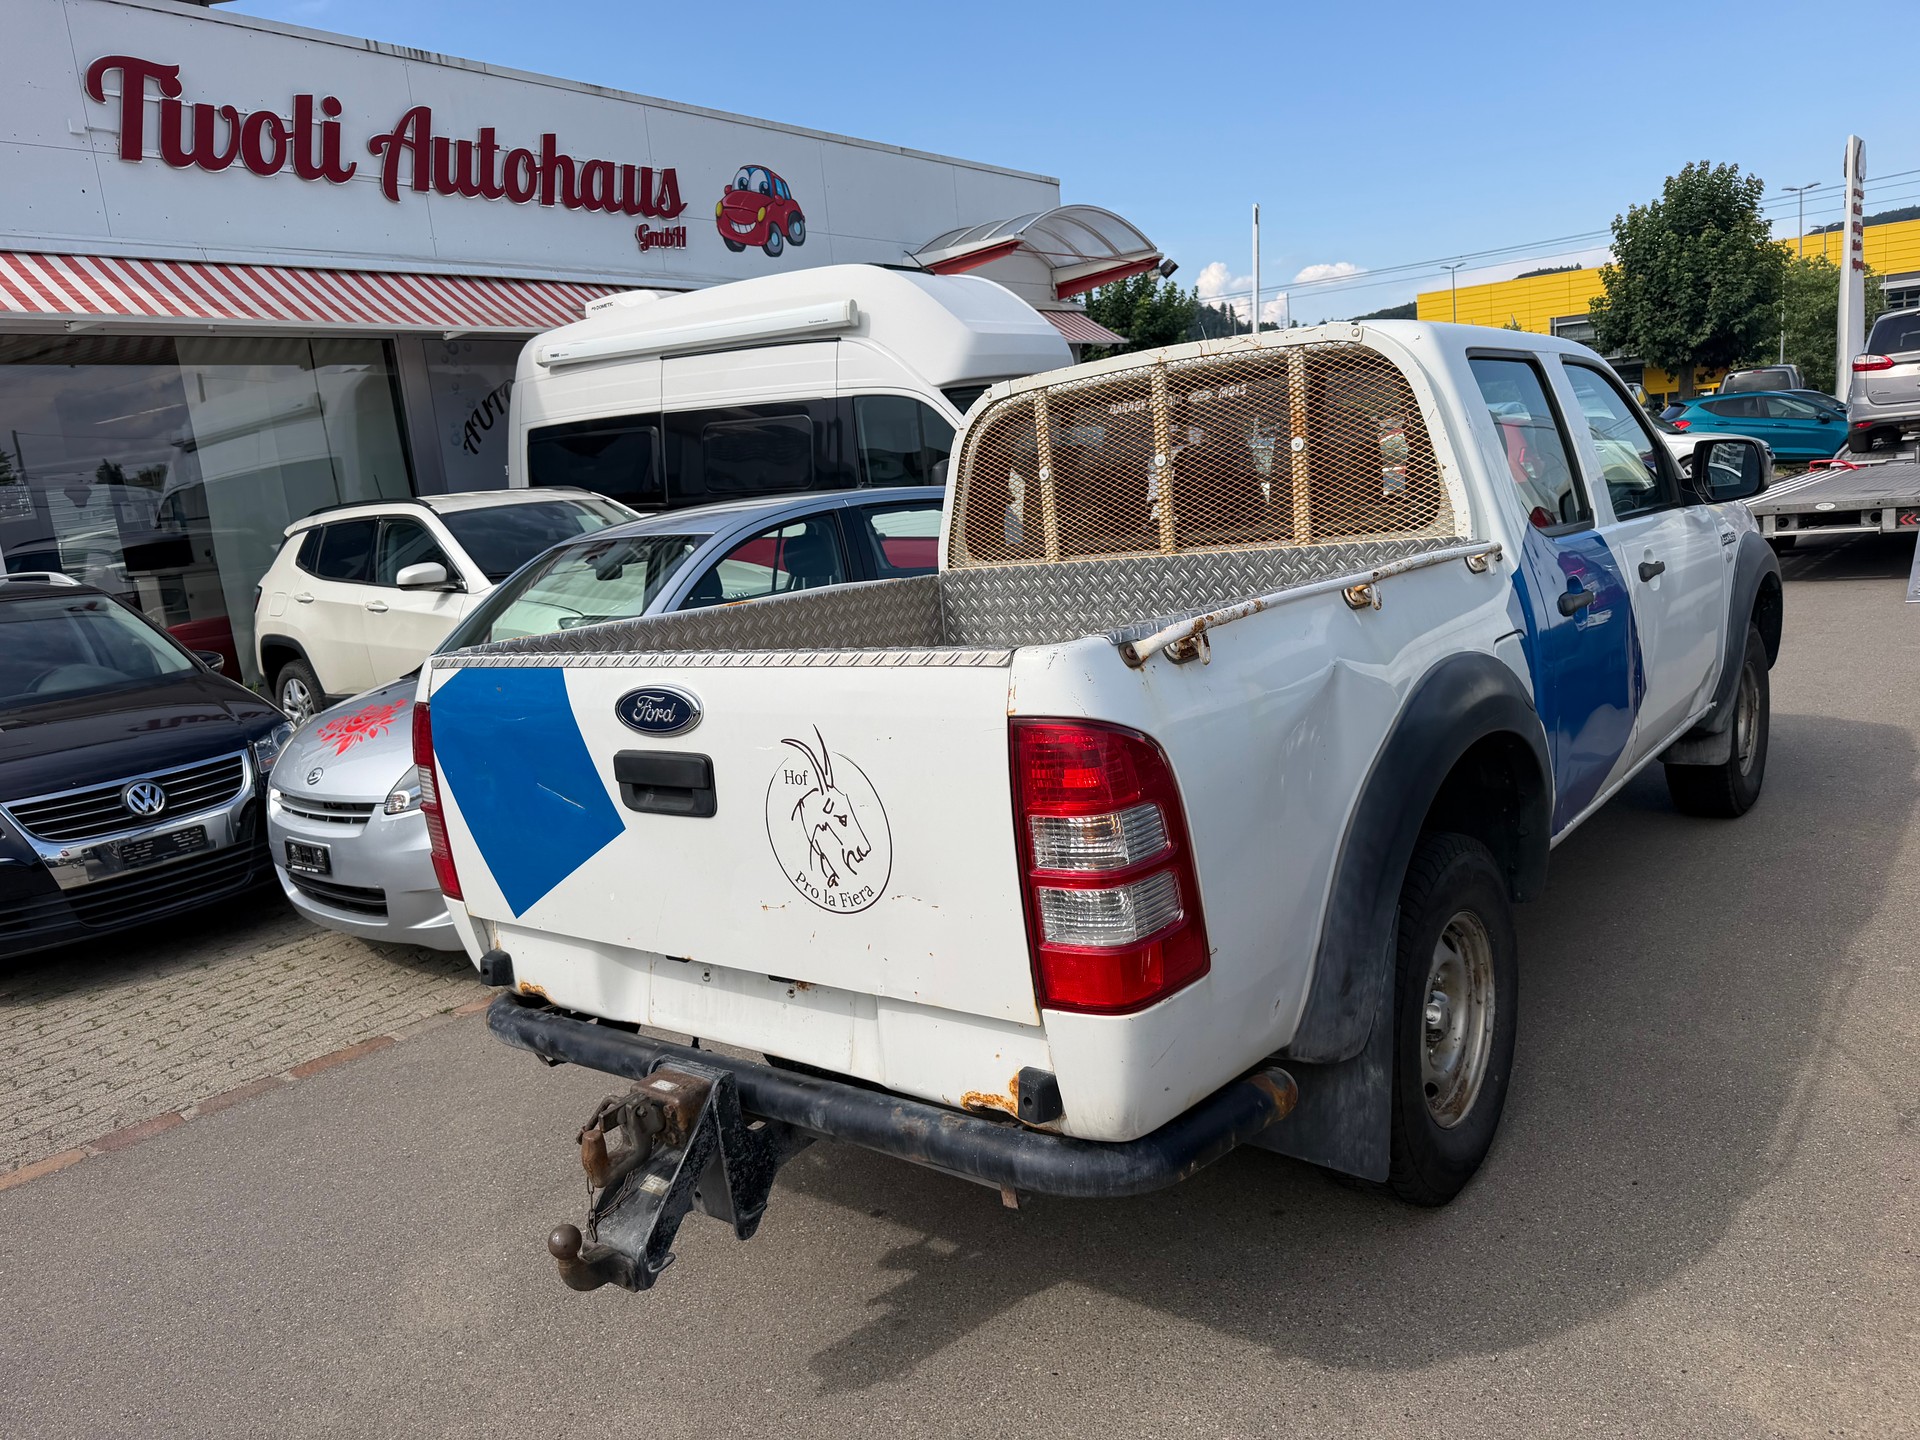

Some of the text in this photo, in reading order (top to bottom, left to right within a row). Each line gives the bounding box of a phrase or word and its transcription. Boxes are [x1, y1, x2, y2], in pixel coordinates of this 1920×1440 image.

[85, 54, 688, 220] Tivoli Autohaus
[636, 223, 687, 252] GmbH
[633, 695, 677, 722] Ford
[784, 769, 808, 786] Hof
[794, 871, 875, 908] Pro la Fiera
